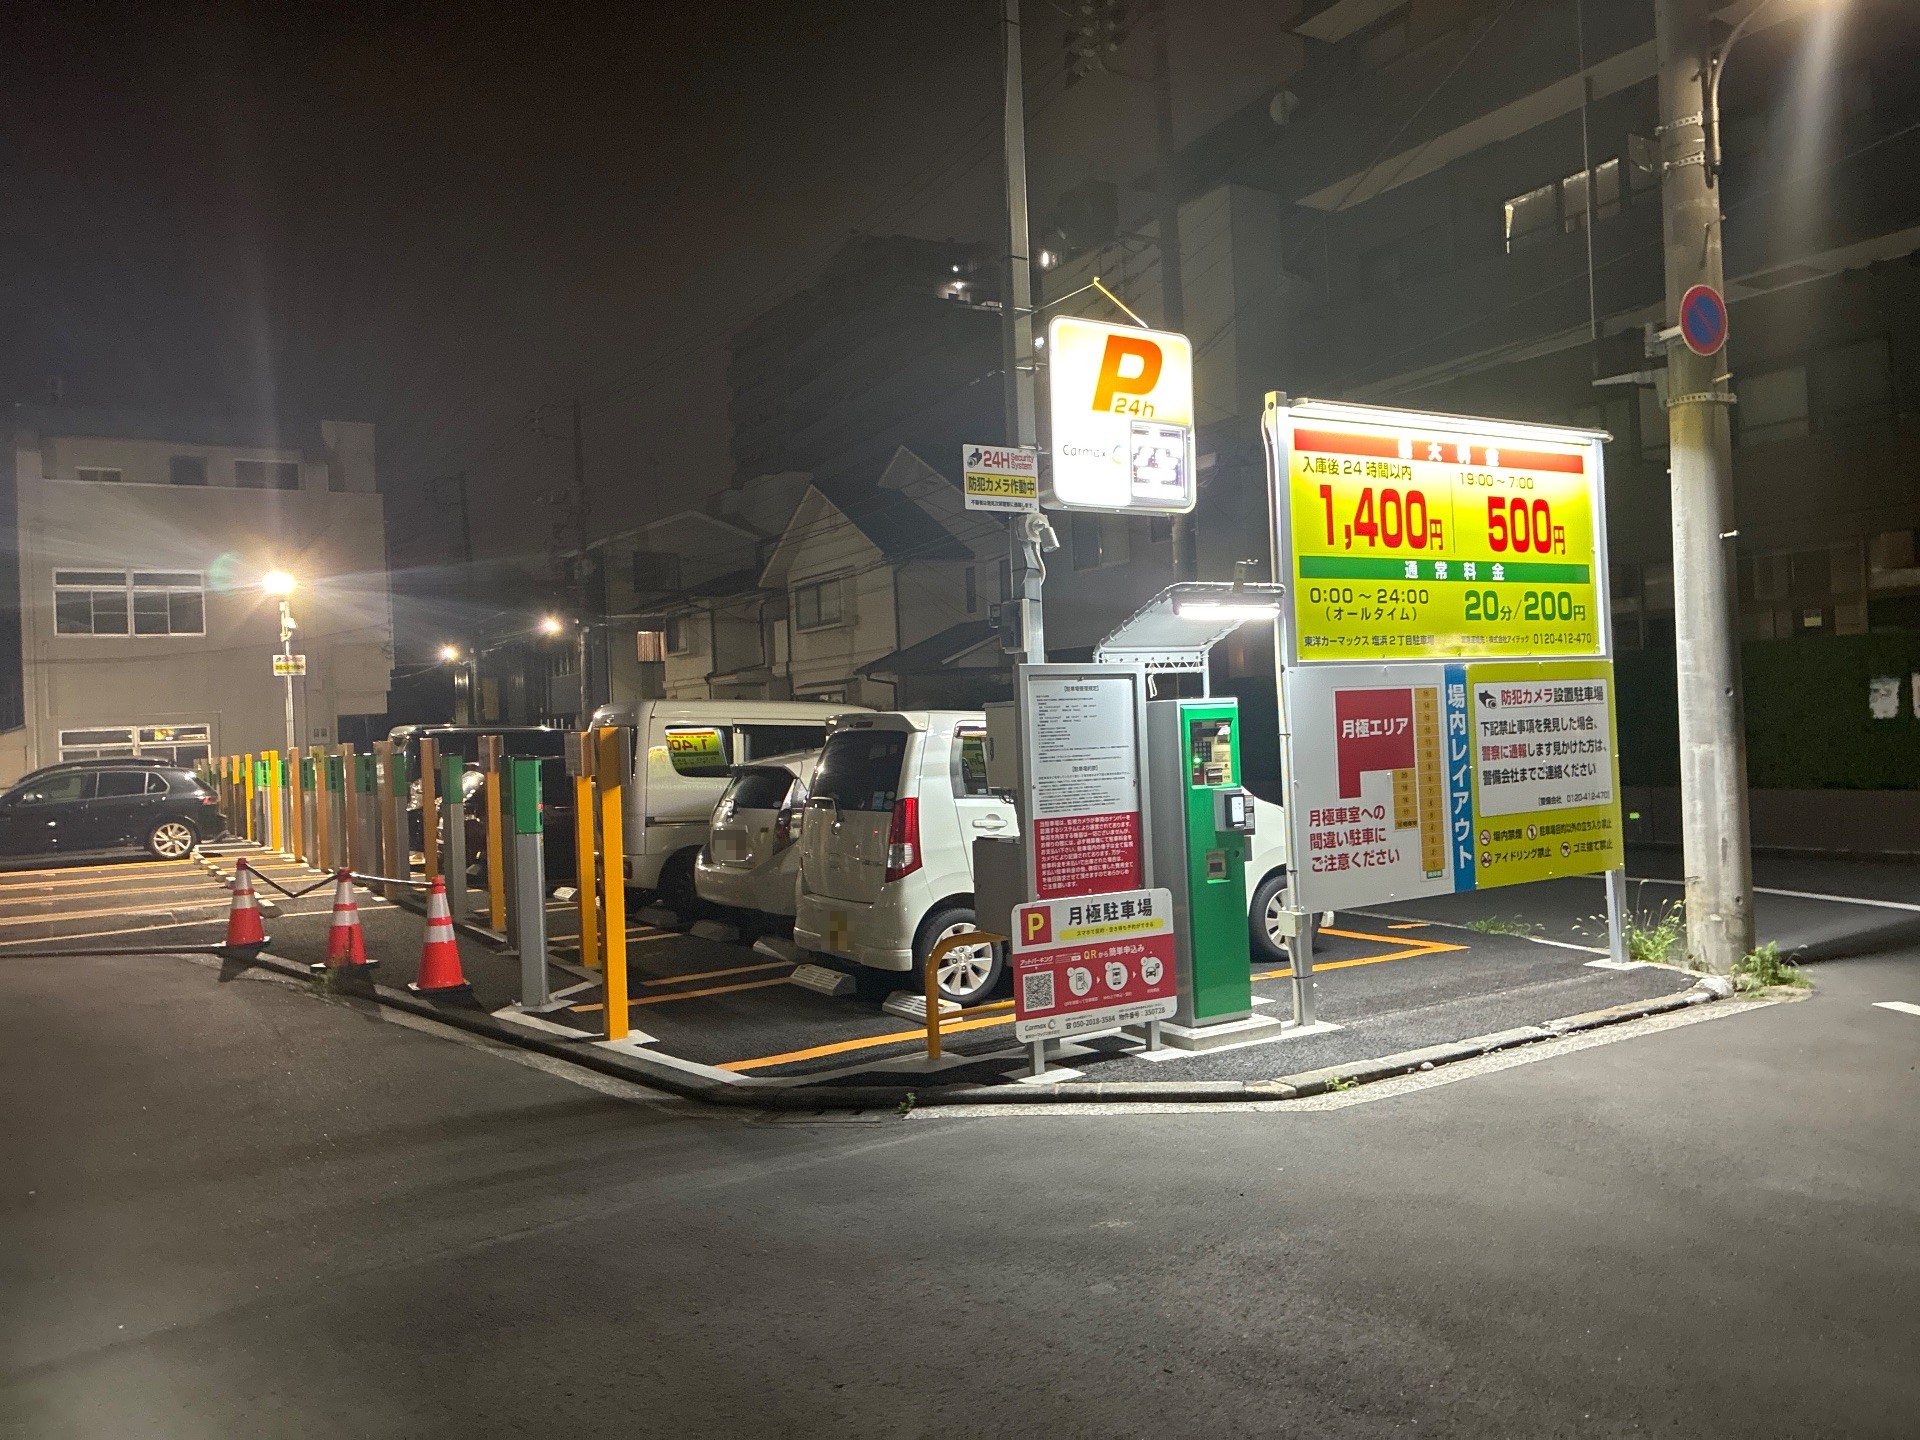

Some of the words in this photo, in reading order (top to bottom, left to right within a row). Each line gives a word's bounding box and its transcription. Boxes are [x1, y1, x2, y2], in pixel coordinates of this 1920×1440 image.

[1092, 334, 1163, 412] P
[1114, 397, 1154, 417] 24h
[983, 450, 1010, 468] 24H
[1011, 453, 1034, 463] Security
[1011, 461, 1033, 470] System
[968, 476, 1035, 495] 防犯カメラ作動中
[1320, 484, 1443, 550] 1,400円
[1488, 496, 1565, 555] 500円
[1405, 561, 1505, 581] 通常料金
[1533, 633, 1592, 645] 0120-412-470
[1501, 686, 1604, 706] 防犯カメラ設置駐車場
[1342, 717, 1409, 739] 月極エリア
[1481, 715, 1597, 737] 下記禁止事項を発見した場合、
[1482, 738, 1607, 761] 警察に通報します見かけた方は、
[1448, 683, 1474, 869] 場内レイアウト
[1482, 763, 1597, 786] 警備会社までご連絡ください
[1309, 805, 1386, 827] 月極車室への
[1309, 827, 1386, 851] 間違い駐車に
[1573, 839, 1613, 853] ゴミ捨て禁止
[1312, 848, 1400, 873] ご注意ください
[1494, 847, 1552, 863] アイドリング禁止
[1068, 898, 1153, 926] 月極駐車場
[1028, 913, 1044, 941] P
[1025, 1023, 1047, 1032] Carmax
